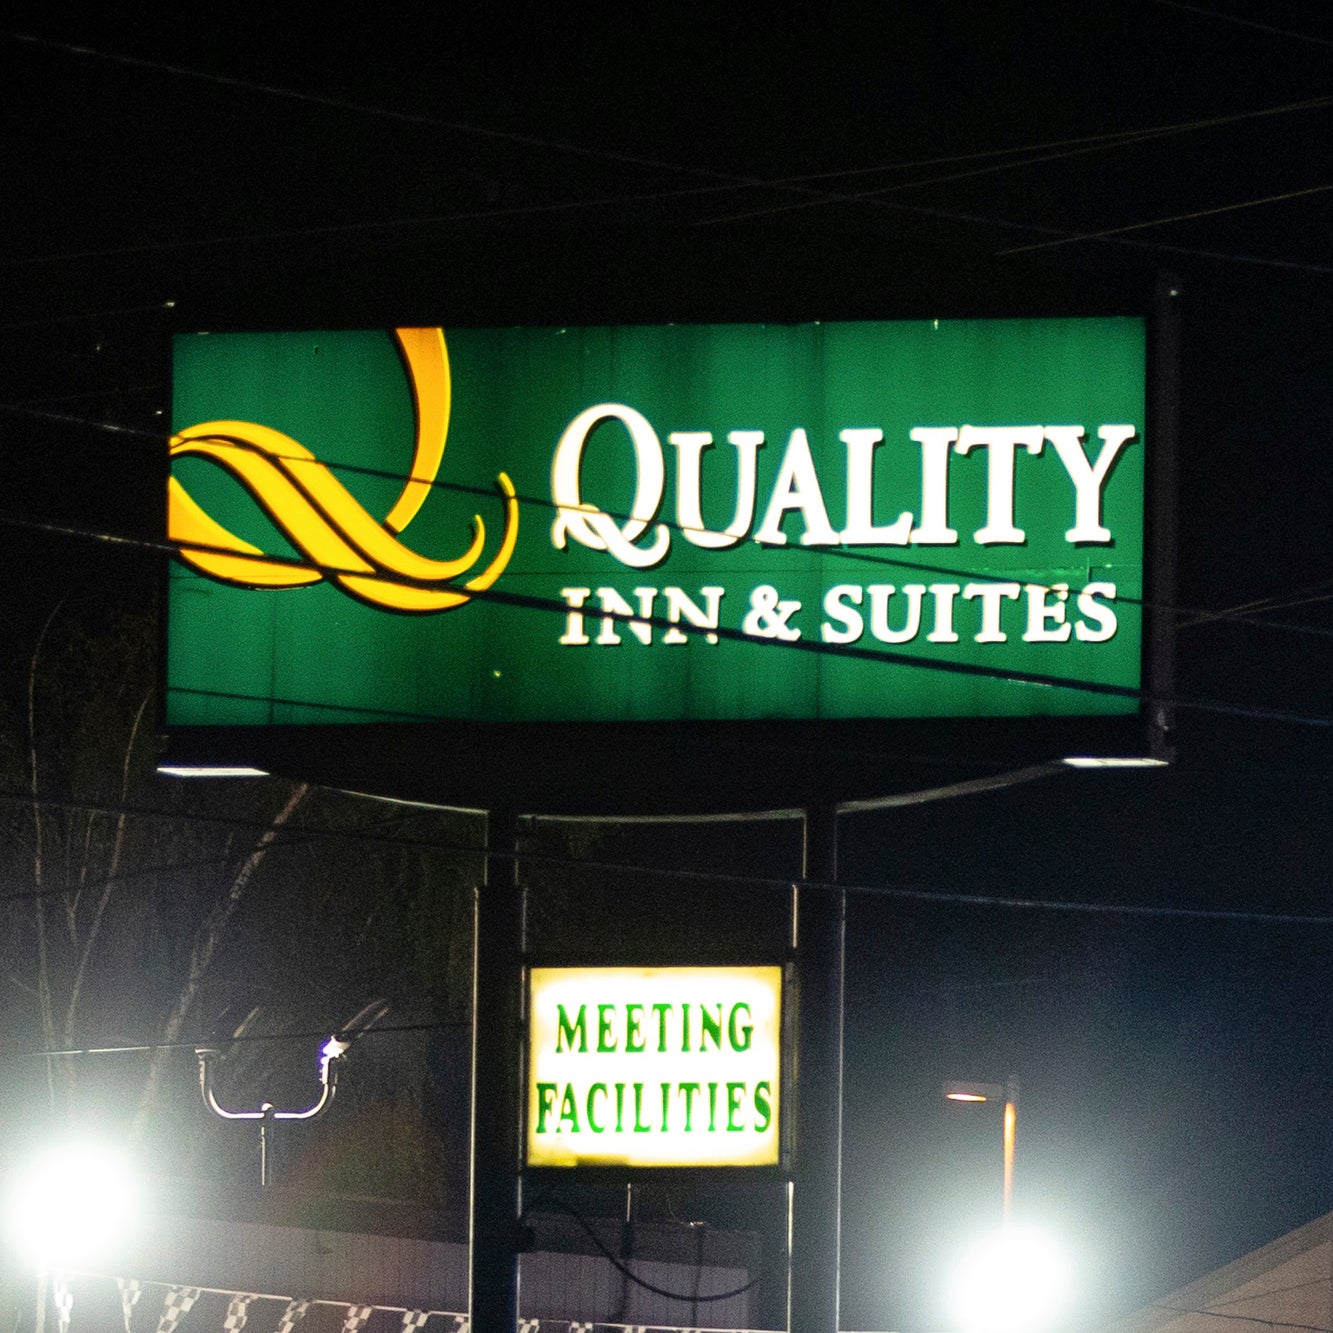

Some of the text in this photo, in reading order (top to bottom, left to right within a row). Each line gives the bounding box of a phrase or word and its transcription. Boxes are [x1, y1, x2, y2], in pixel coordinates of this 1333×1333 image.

[551, 402, 1136, 568] QUALITY
[559, 582, 1119, 646] INN & SUITES
[555, 1002, 754, 1054] MEETING
[535, 1081, 772, 1134] FACILITIES
